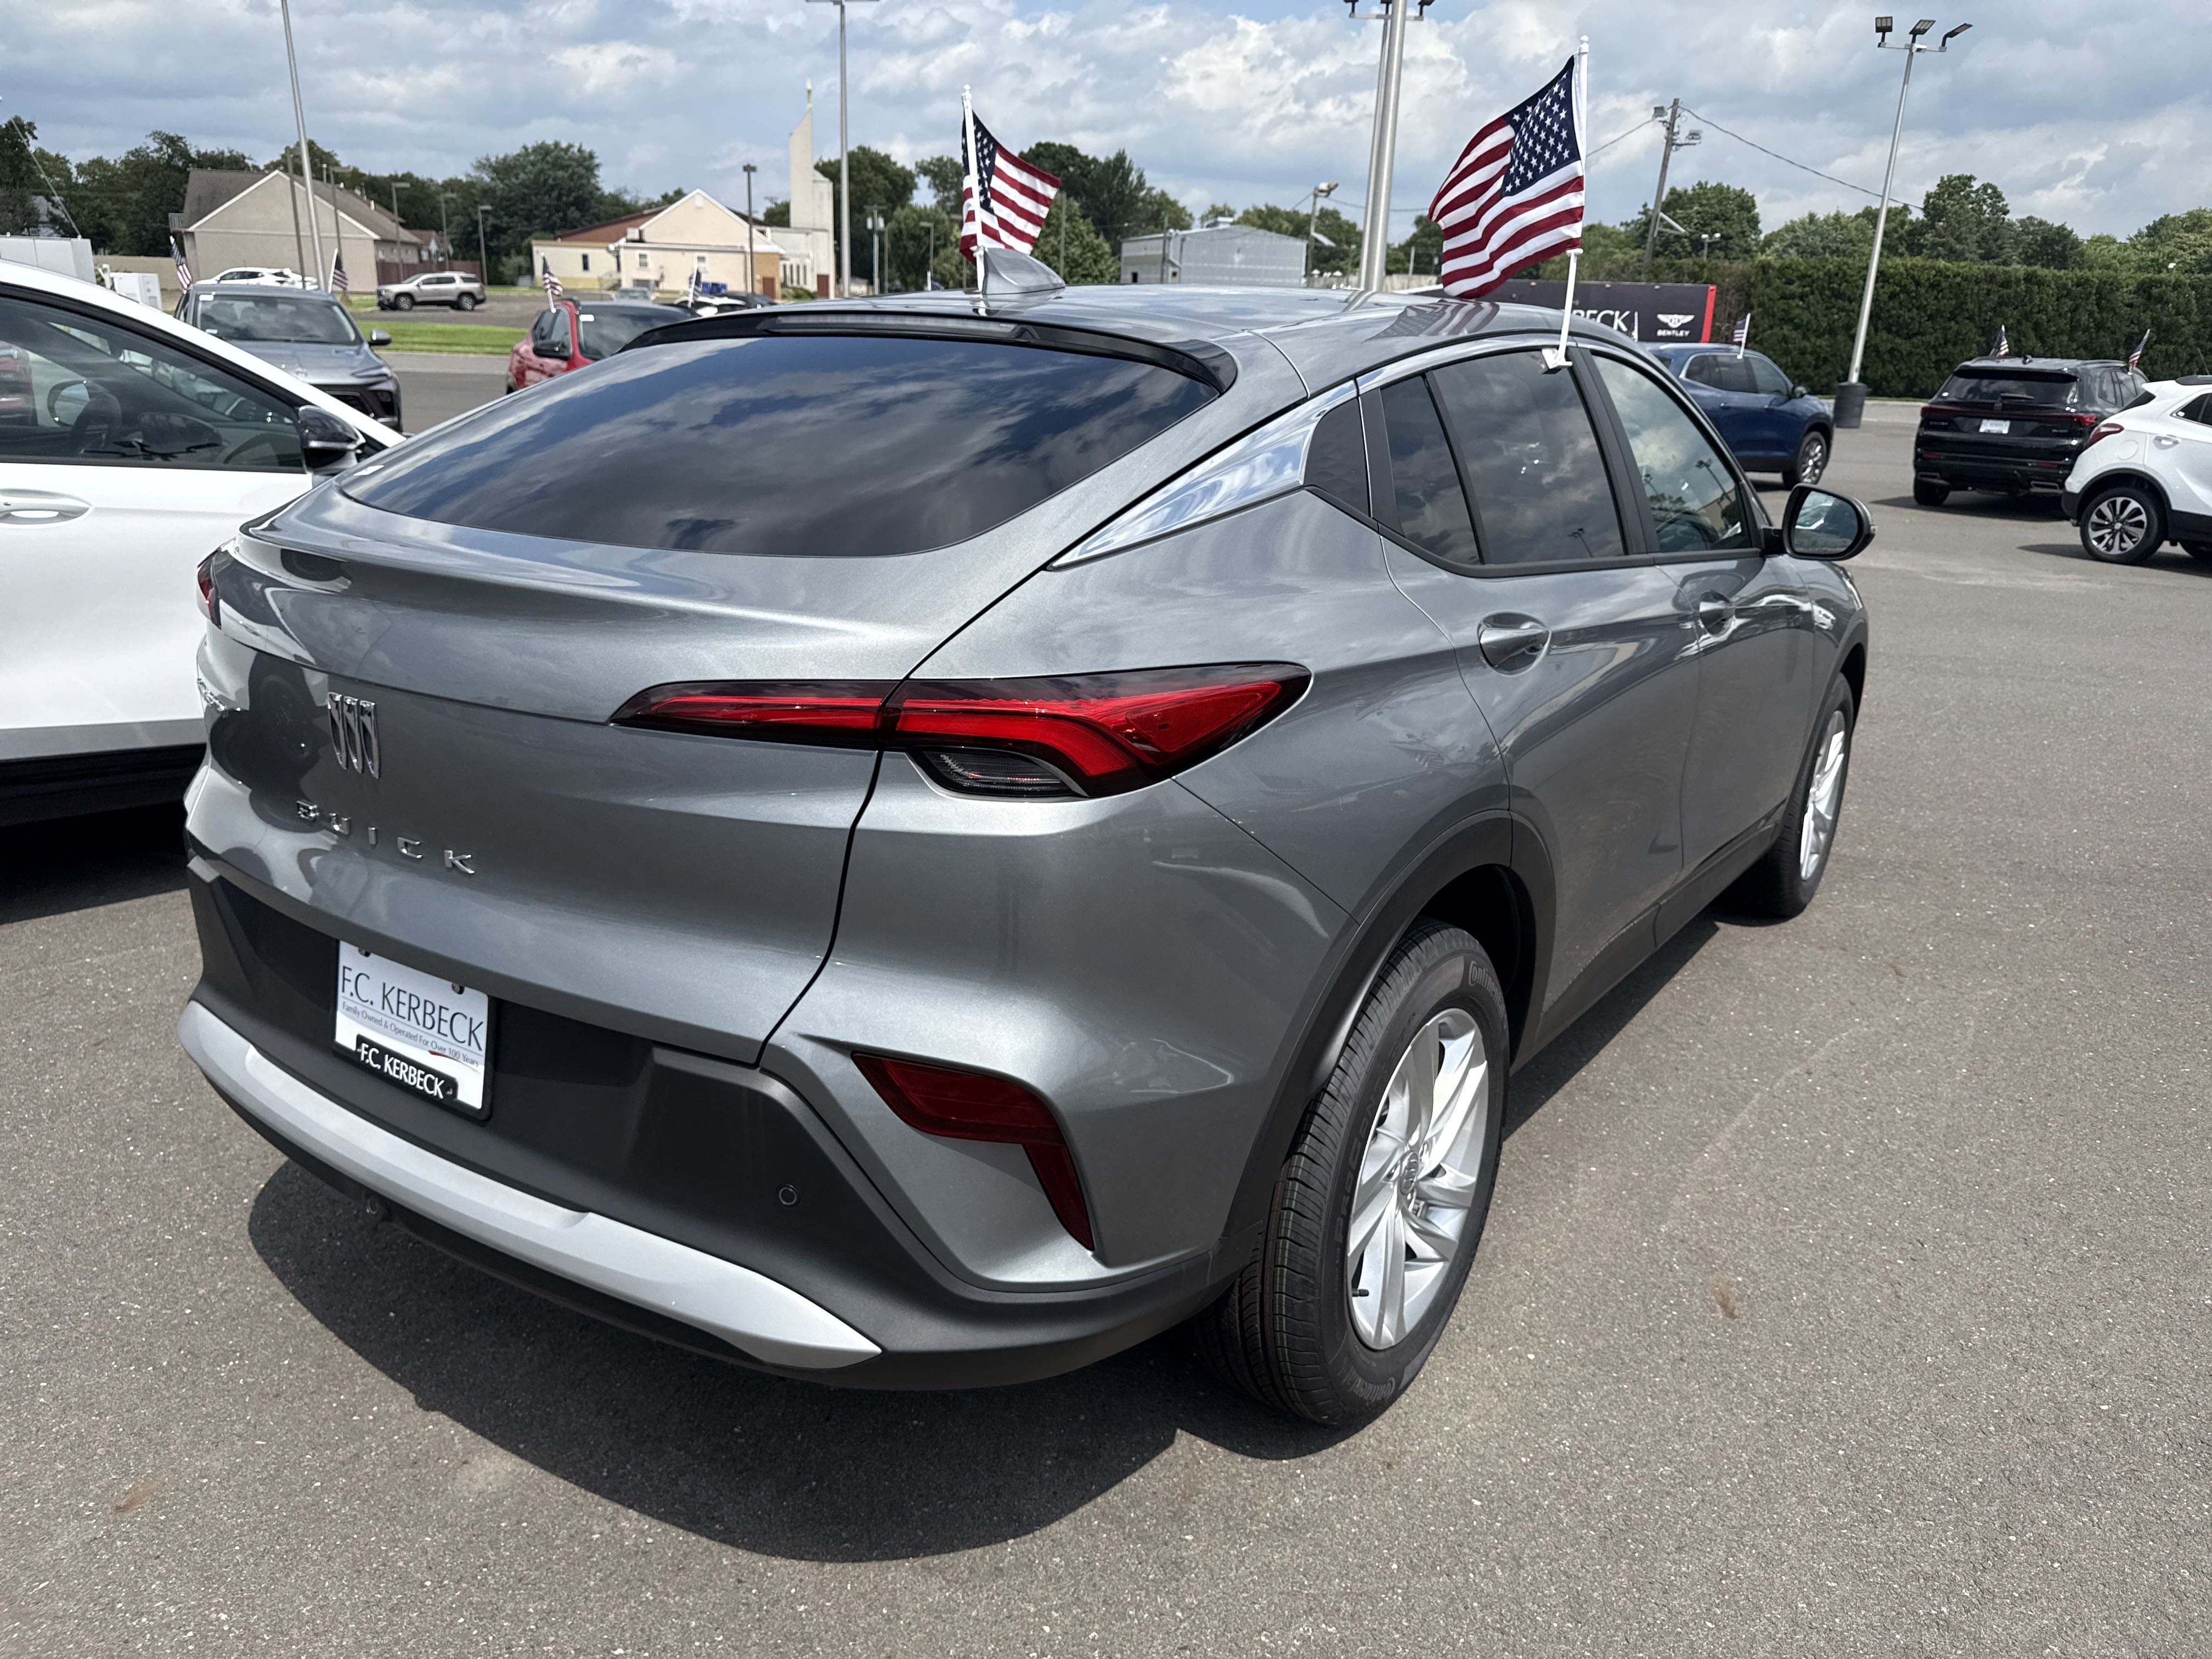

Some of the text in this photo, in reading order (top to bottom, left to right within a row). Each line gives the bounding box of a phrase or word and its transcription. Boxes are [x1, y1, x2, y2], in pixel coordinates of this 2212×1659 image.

[296, 800, 475, 874] BUICK
[342, 966, 484, 1051] F.C. KERBECK
[1468, 960, 1506, 1019] Continental
[342, 1001, 479, 1068] Family Owned & Operated For Over 100 Years
[360, 1042, 445, 1099] F.C. KERBECK
